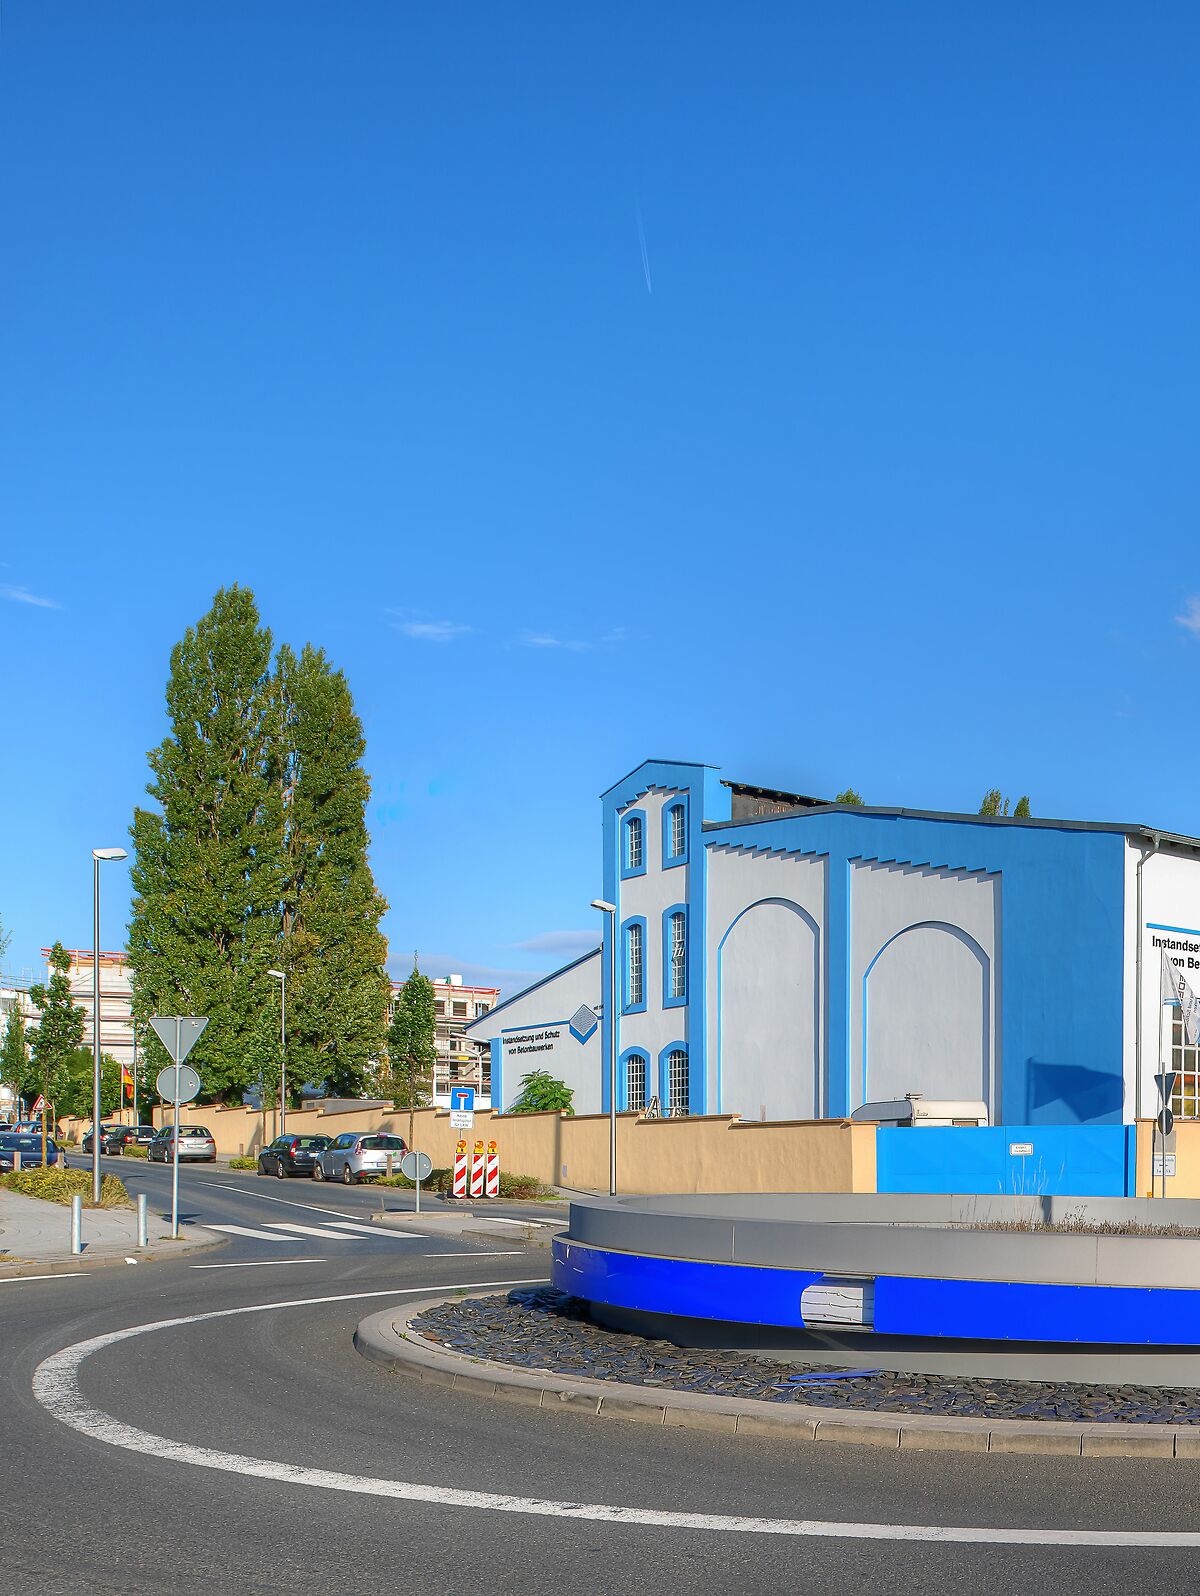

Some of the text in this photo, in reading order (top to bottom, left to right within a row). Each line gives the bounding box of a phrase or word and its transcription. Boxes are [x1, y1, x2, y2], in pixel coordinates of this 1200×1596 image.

[502, 1030, 561, 1045] Instandsetzung und Schutz
[508, 1043, 554, 1055] von Betonbauwerken
